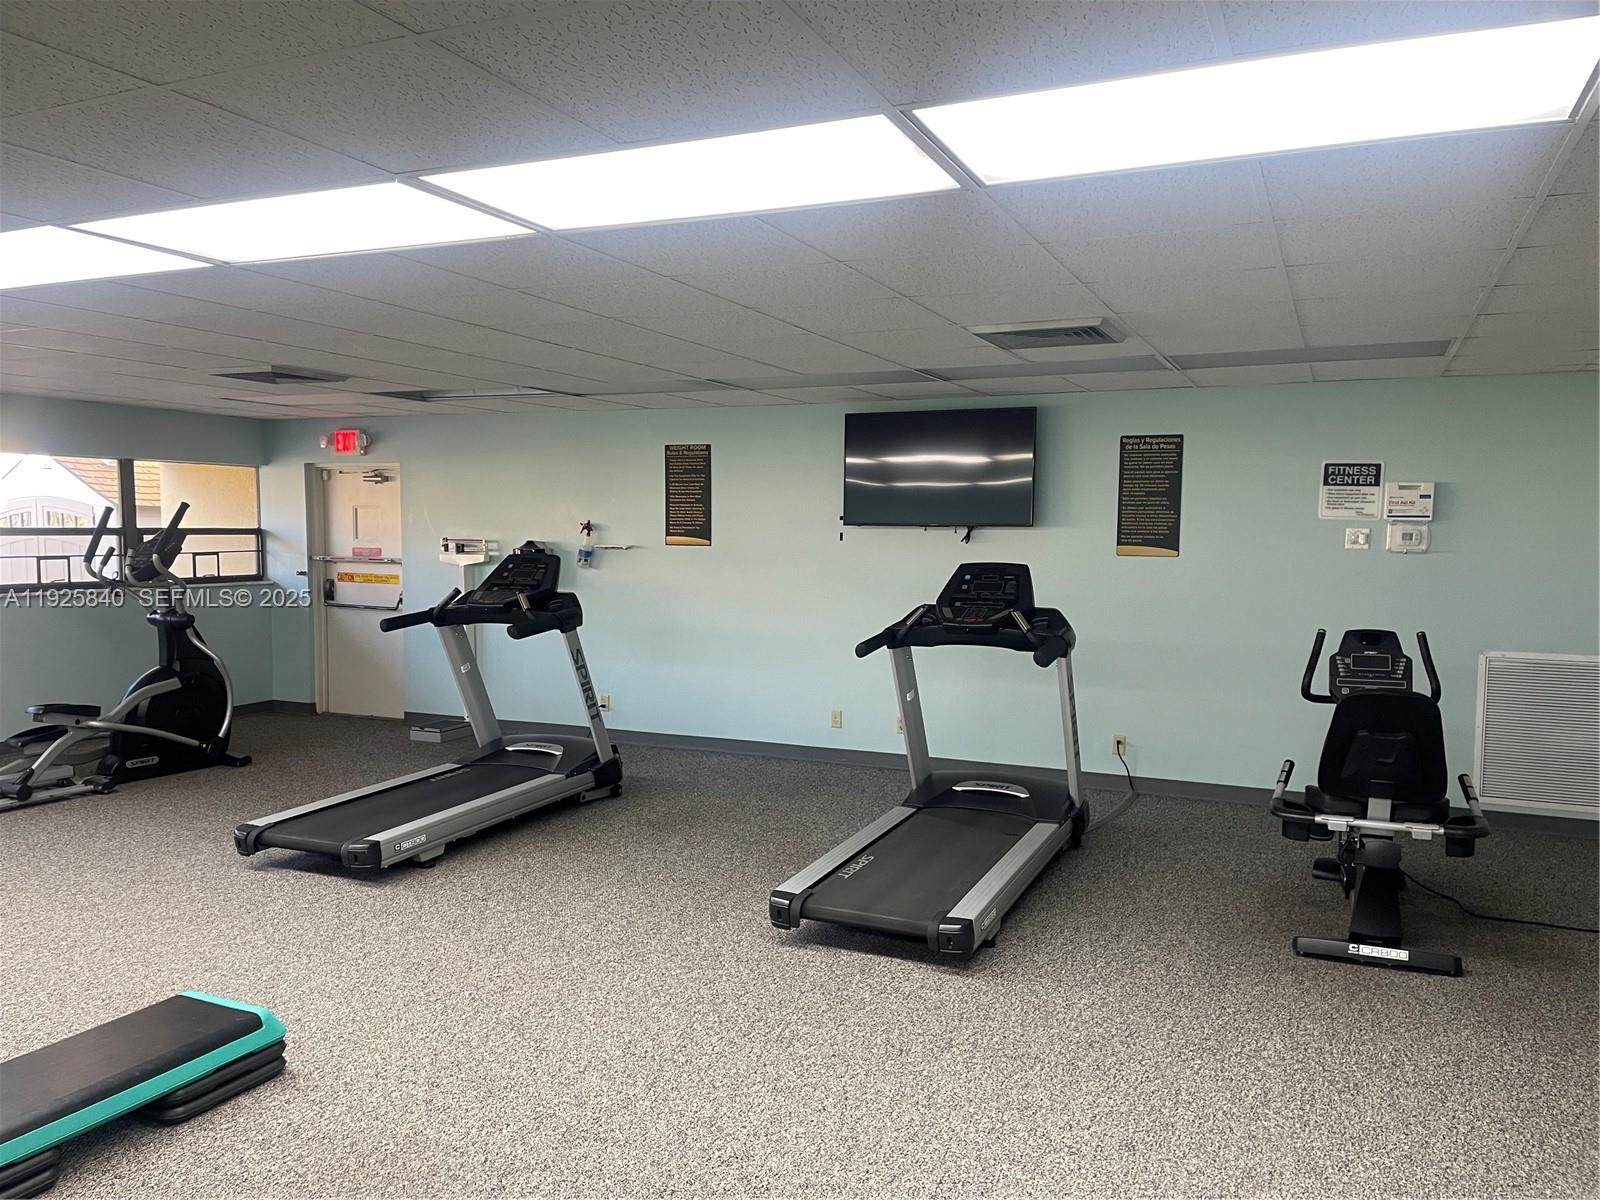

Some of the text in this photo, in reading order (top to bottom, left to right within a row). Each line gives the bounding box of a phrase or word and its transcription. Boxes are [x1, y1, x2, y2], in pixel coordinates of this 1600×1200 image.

[1328, 466, 1377, 475] FITNESS
[1328, 475, 1376, 485] CENTER
[570, 648, 602, 721] SPIRIT
[838, 854, 875, 880] SPIRIT
[1361, 946, 1408, 960] CR800
